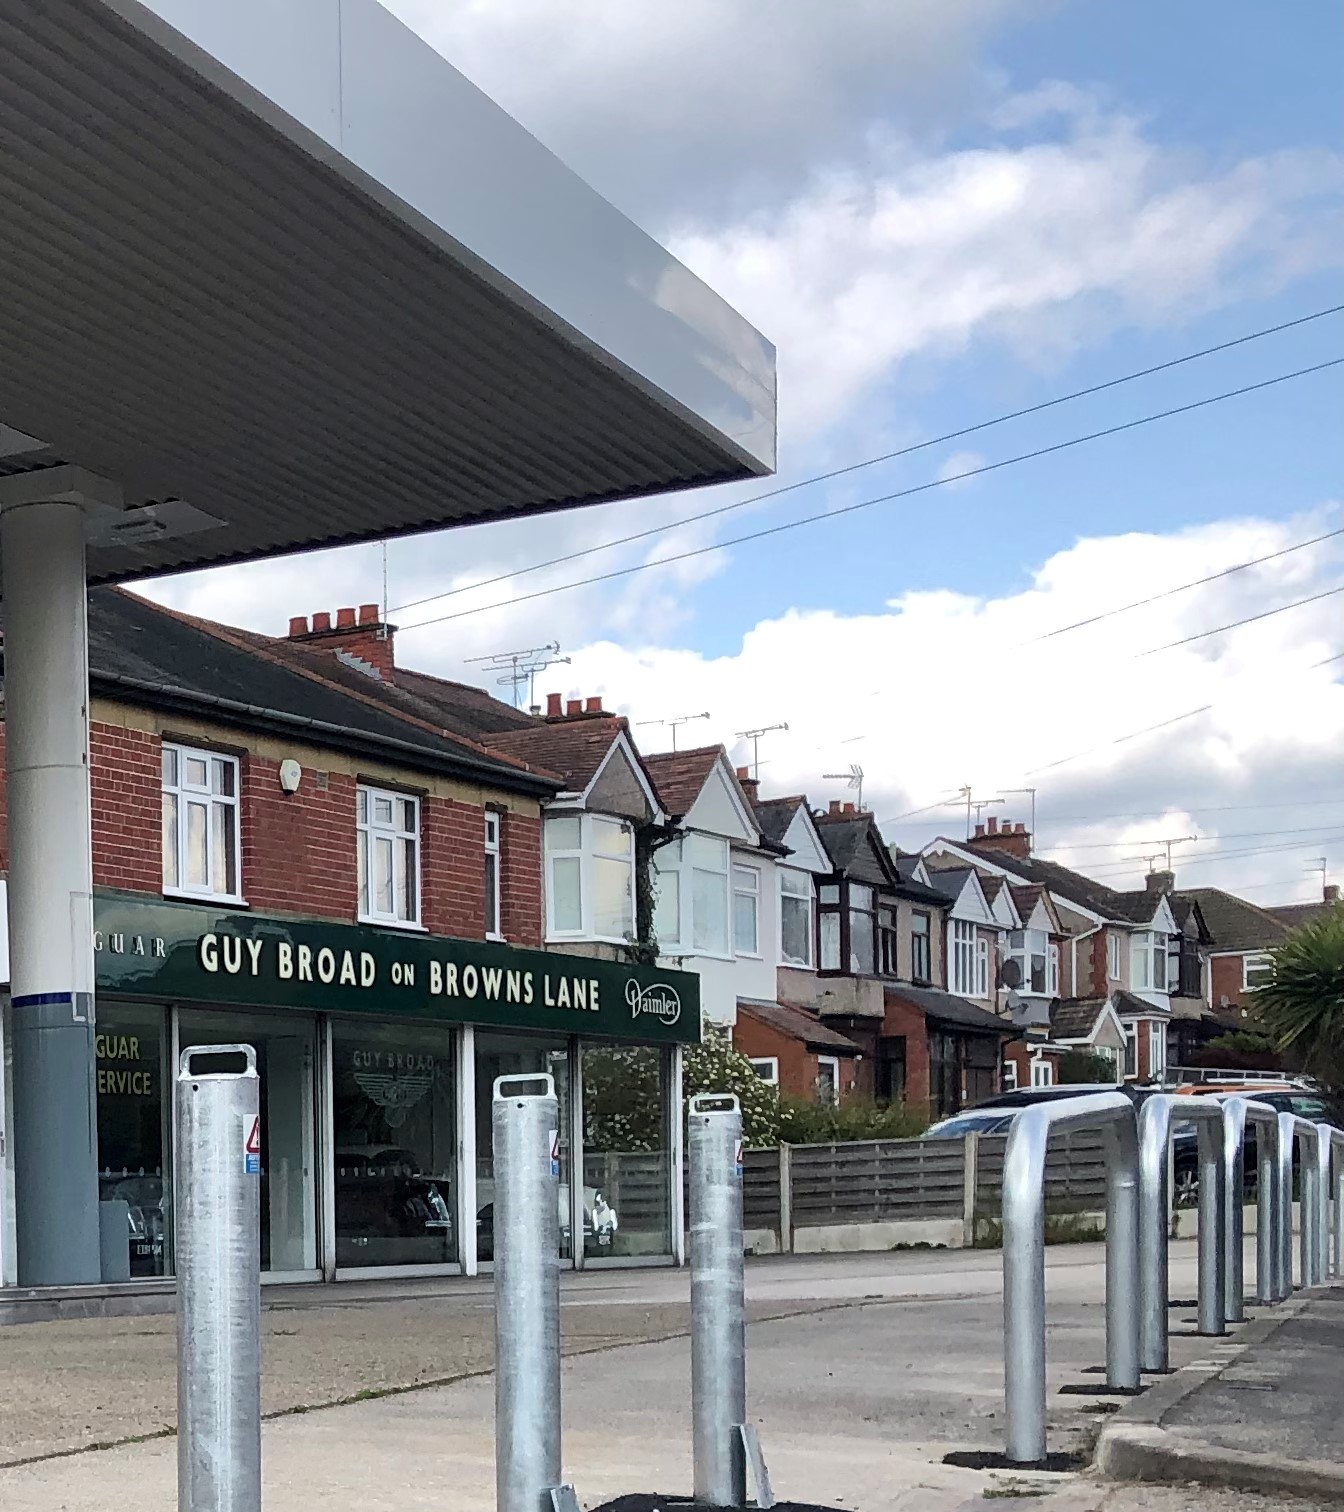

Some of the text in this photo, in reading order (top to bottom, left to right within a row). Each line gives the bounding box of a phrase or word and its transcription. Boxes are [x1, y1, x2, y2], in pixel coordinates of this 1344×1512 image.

[200, 933, 600, 1011] GUY BROAD ON BROWNS LANE
[625, 978, 681, 1025] Daimler
[95, 1034, 140, 1060] GUAR
[353, 1050, 381, 1067] GUY
[97, 1070, 152, 1095] ERVICE
